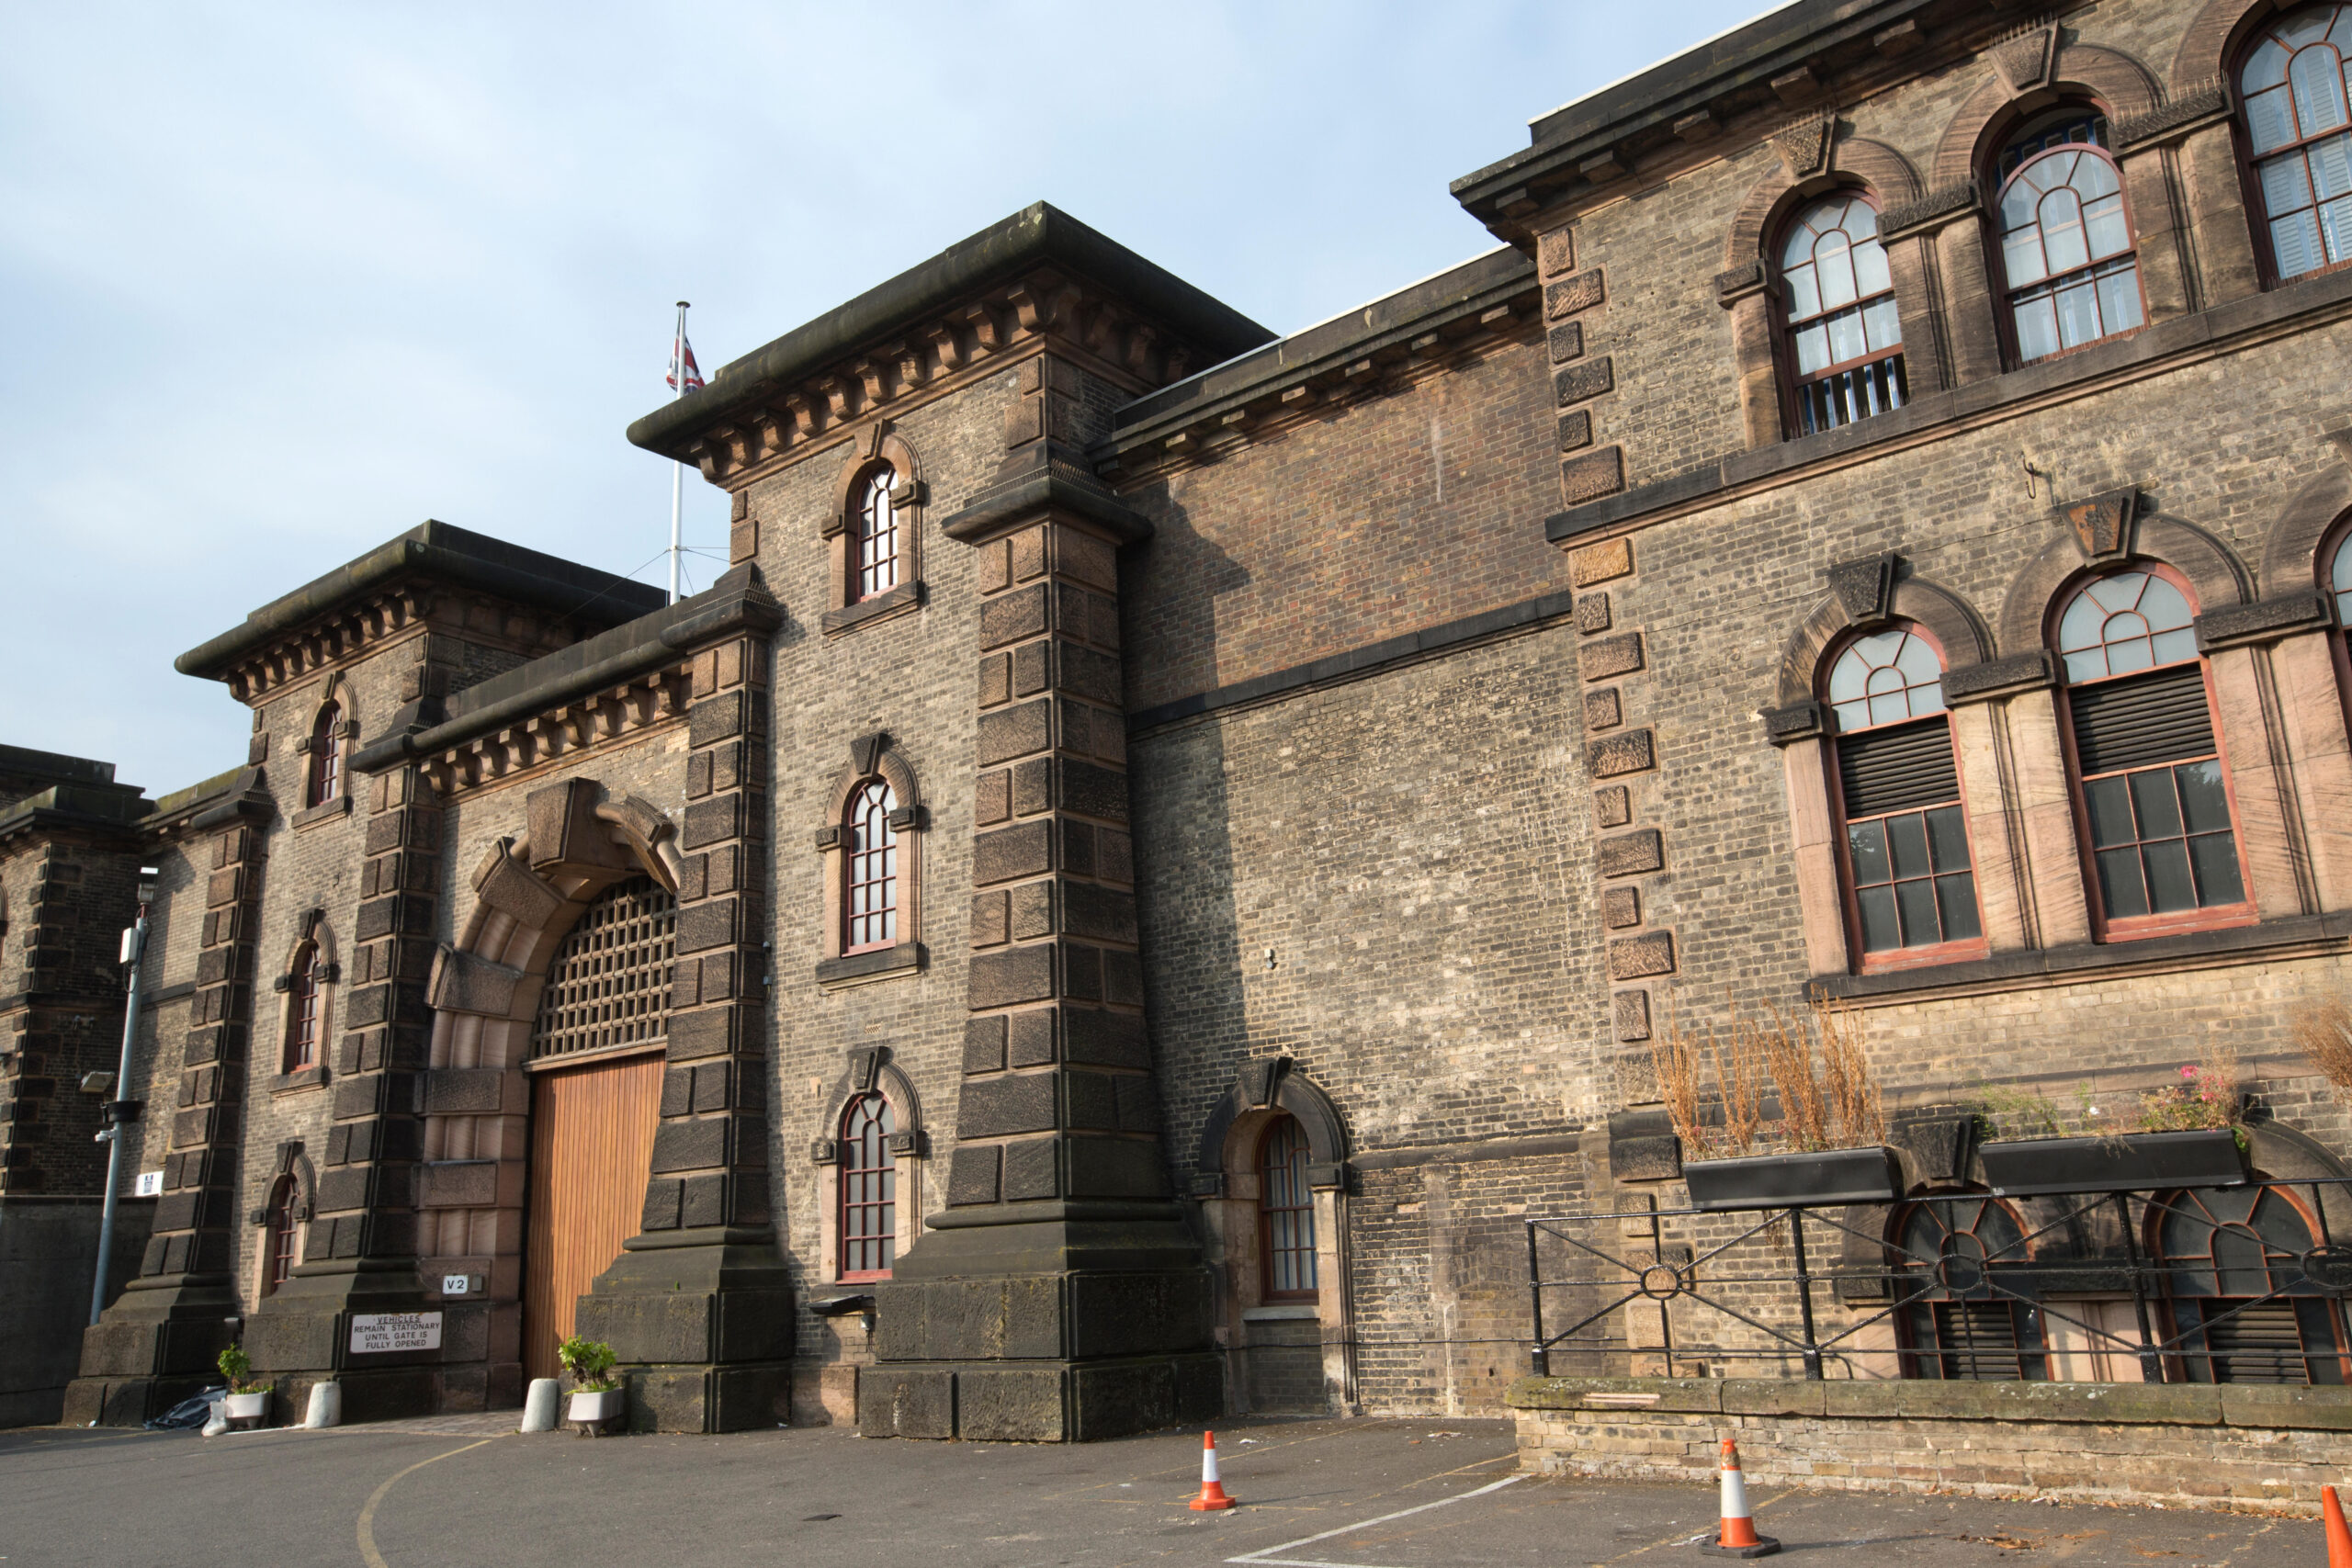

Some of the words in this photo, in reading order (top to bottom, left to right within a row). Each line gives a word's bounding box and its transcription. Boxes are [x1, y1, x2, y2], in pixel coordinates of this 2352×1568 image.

[378, 1314, 421, 1324] VEHICLES
[354, 1325, 386, 1333] REMAIN
[391, 1323, 440, 1331] STATIONARY
[395, 1339, 426, 1348] OPENED
